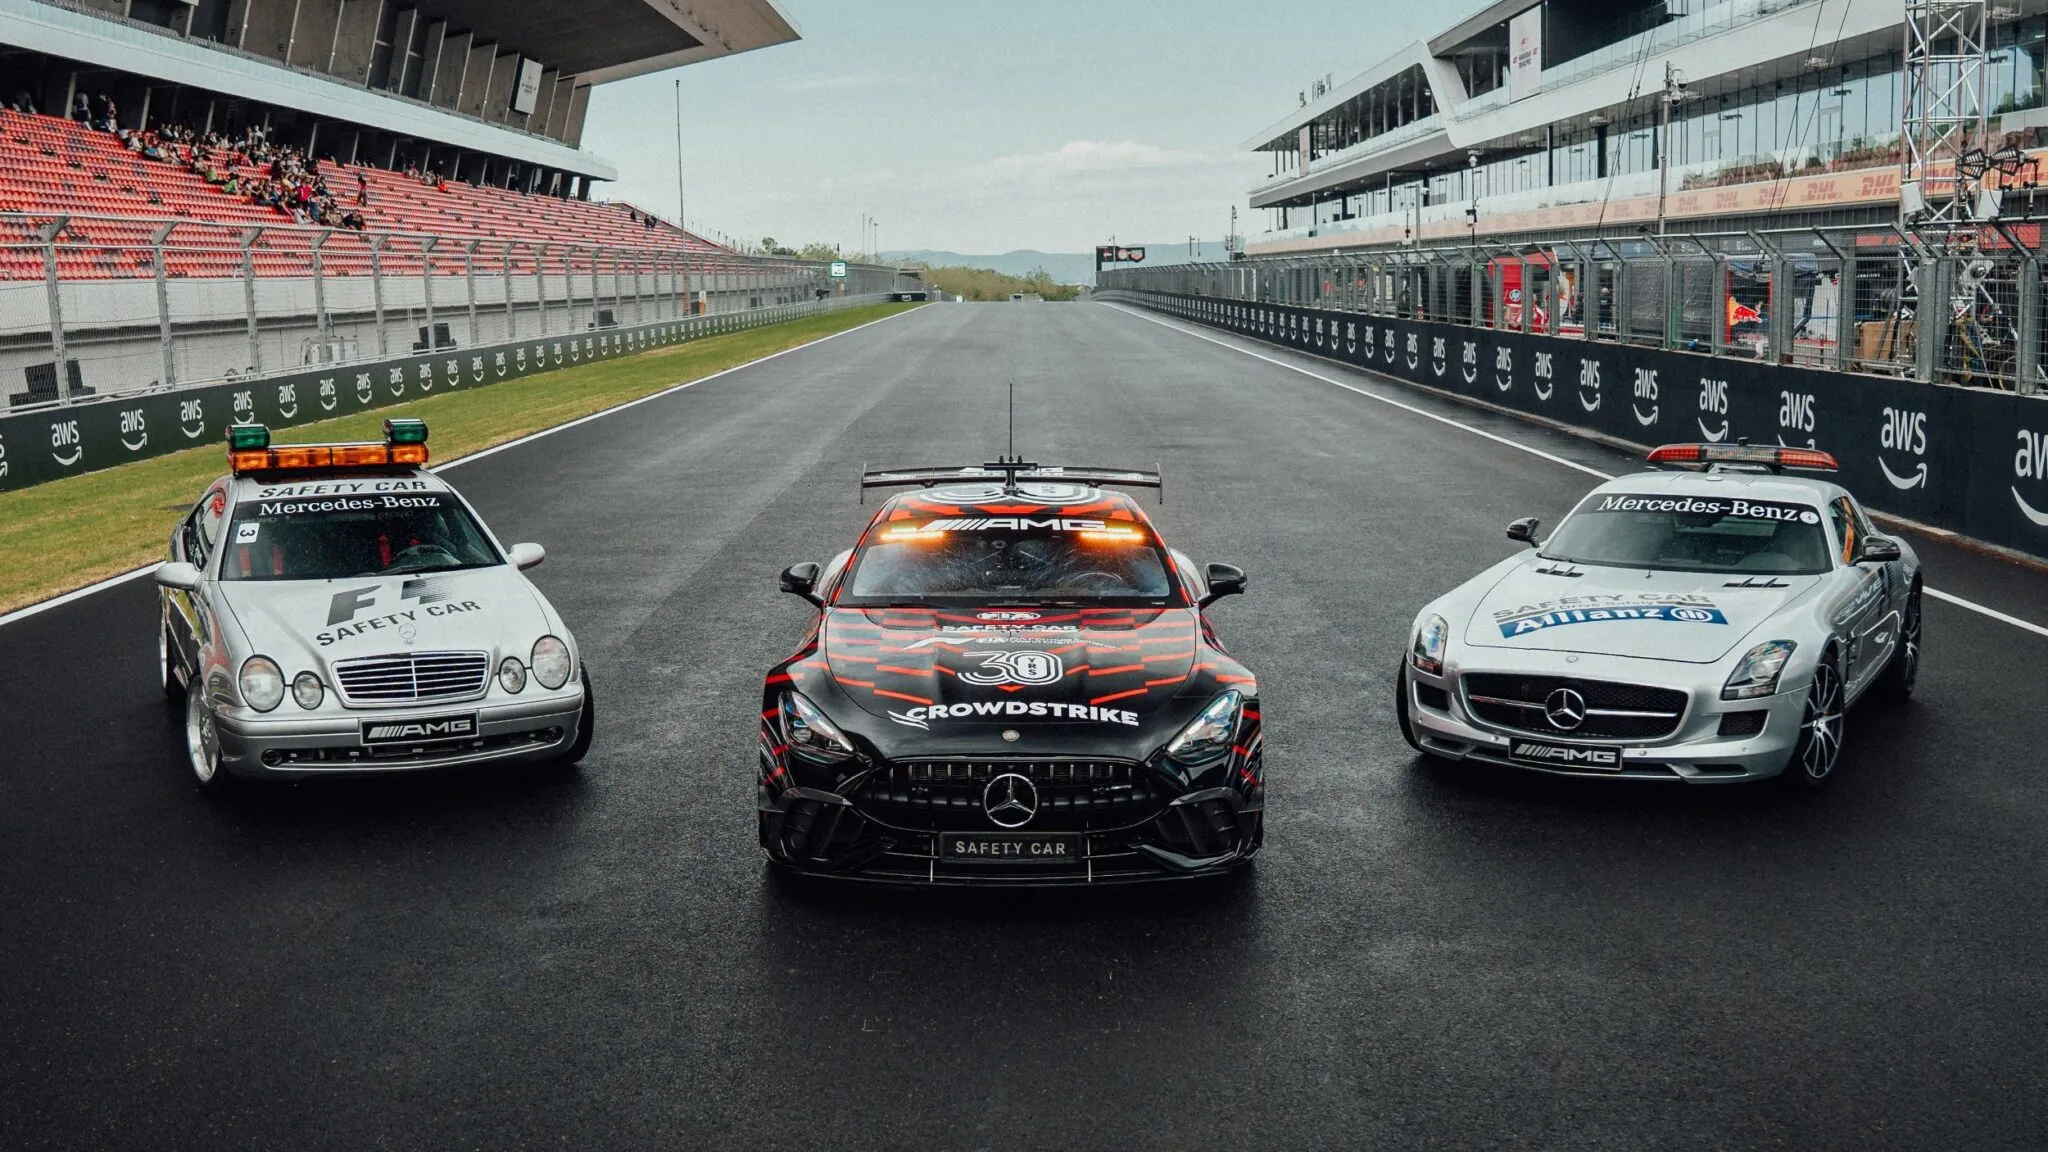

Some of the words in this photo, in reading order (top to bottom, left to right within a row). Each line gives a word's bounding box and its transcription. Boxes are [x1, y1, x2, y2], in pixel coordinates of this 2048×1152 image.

[1806, 180, 1836, 201] DHL
[1862, 174, 1895, 196] DHL
[1463, 342, 1476, 364] aws
[1497, 347, 1511, 371] aws
[390, 368, 402, 384] aws
[1536, 352, 1552, 379] aws
[1581, 359, 1600, 388] aws
[320, 378, 335, 396] aws
[357, 373, 370, 390] aws
[1635, 368, 1657, 400] aws
[234, 391, 252, 411] aws
[279, 384, 295, 403] aws
[1700, 378, 1727, 414] aws
[121, 409, 144, 433] aws
[181, 399, 202, 421] aws
[1780, 391, 1814, 432] aws
[51, 420, 79, 447] aws
[1881, 407, 1926, 455] aws
[2015, 430, 2048, 479] aw
[259, 482, 364, 499] SAFETY
[375, 481, 428, 491] CAR
[259, 496, 440, 516] Mercedes-Benz
[1597, 496, 1799, 521] Mercedes-Benz
[239, 529, 256, 538] 3
[978, 519, 1107, 531] AMG
[1493, 593, 1623, 618] SAFETY
[1638, 593, 1712, 603] CAR
[316, 610, 417, 647] SAFETY
[426, 601, 482, 617] CAR
[943, 625, 1028, 633] SAFETY
[1032, 625, 1078, 633] CAR
[1514, 608, 1664, 634] Allianz
[957, 650, 1064, 686] 30
[1027, 657, 1036, 676] YRS
[906, 701, 1139, 726] CROWDSTRIKE
[400, 719, 471, 737] AMG
[1547, 748, 1616, 763] AMG
[956, 841, 1023, 855] SAFETY
[1031, 842, 1066, 855] CAR
